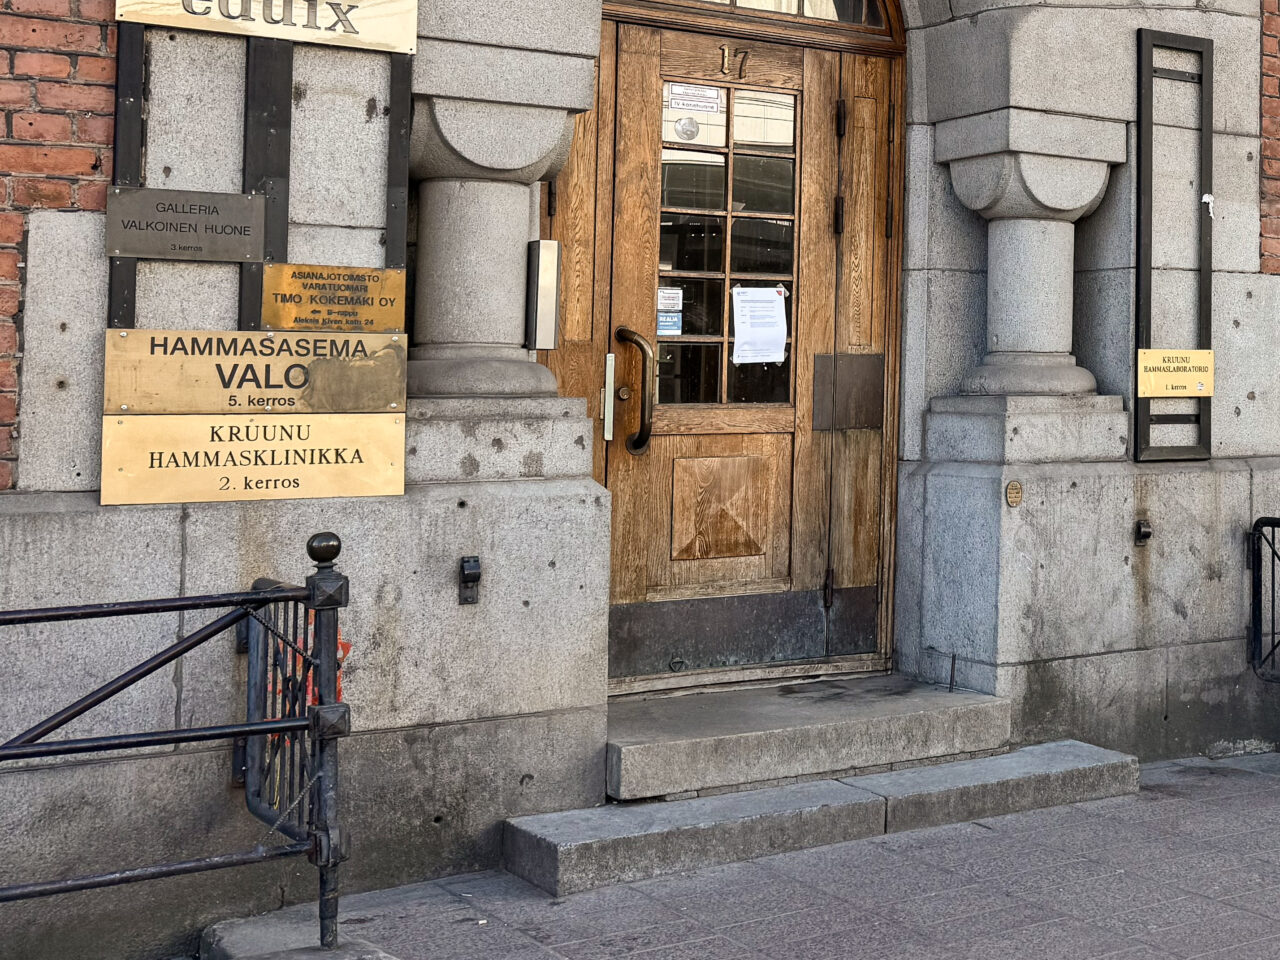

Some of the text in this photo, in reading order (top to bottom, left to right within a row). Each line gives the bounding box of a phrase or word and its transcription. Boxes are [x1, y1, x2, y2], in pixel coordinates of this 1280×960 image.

[719, 43, 749, 80] 17
[155, 202, 220, 216] GALLERIA
[121, 219, 251, 237] VALKOINEN HUONE
[291, 271, 380, 283] ASIANAJOTOIMISTO
[302, 282, 368, 293] VARATUOMARI
[272, 292, 303, 304] TIMO
[379, 297, 396, 307] OY
[149, 336, 369, 358] HAMMASASEMA
[1162, 356, 1191, 364] KRUUNU
[215, 363, 310, 390] VALO
[1143, 365, 1209, 373] HAMMASLABORATORIO
[227, 394, 296, 408] 5. kerros
[209, 424, 312, 443] KRUUNU
[148, 448, 365, 470] HAMMASKLINIKKA
[218, 475, 301, 491] 2. kerros
